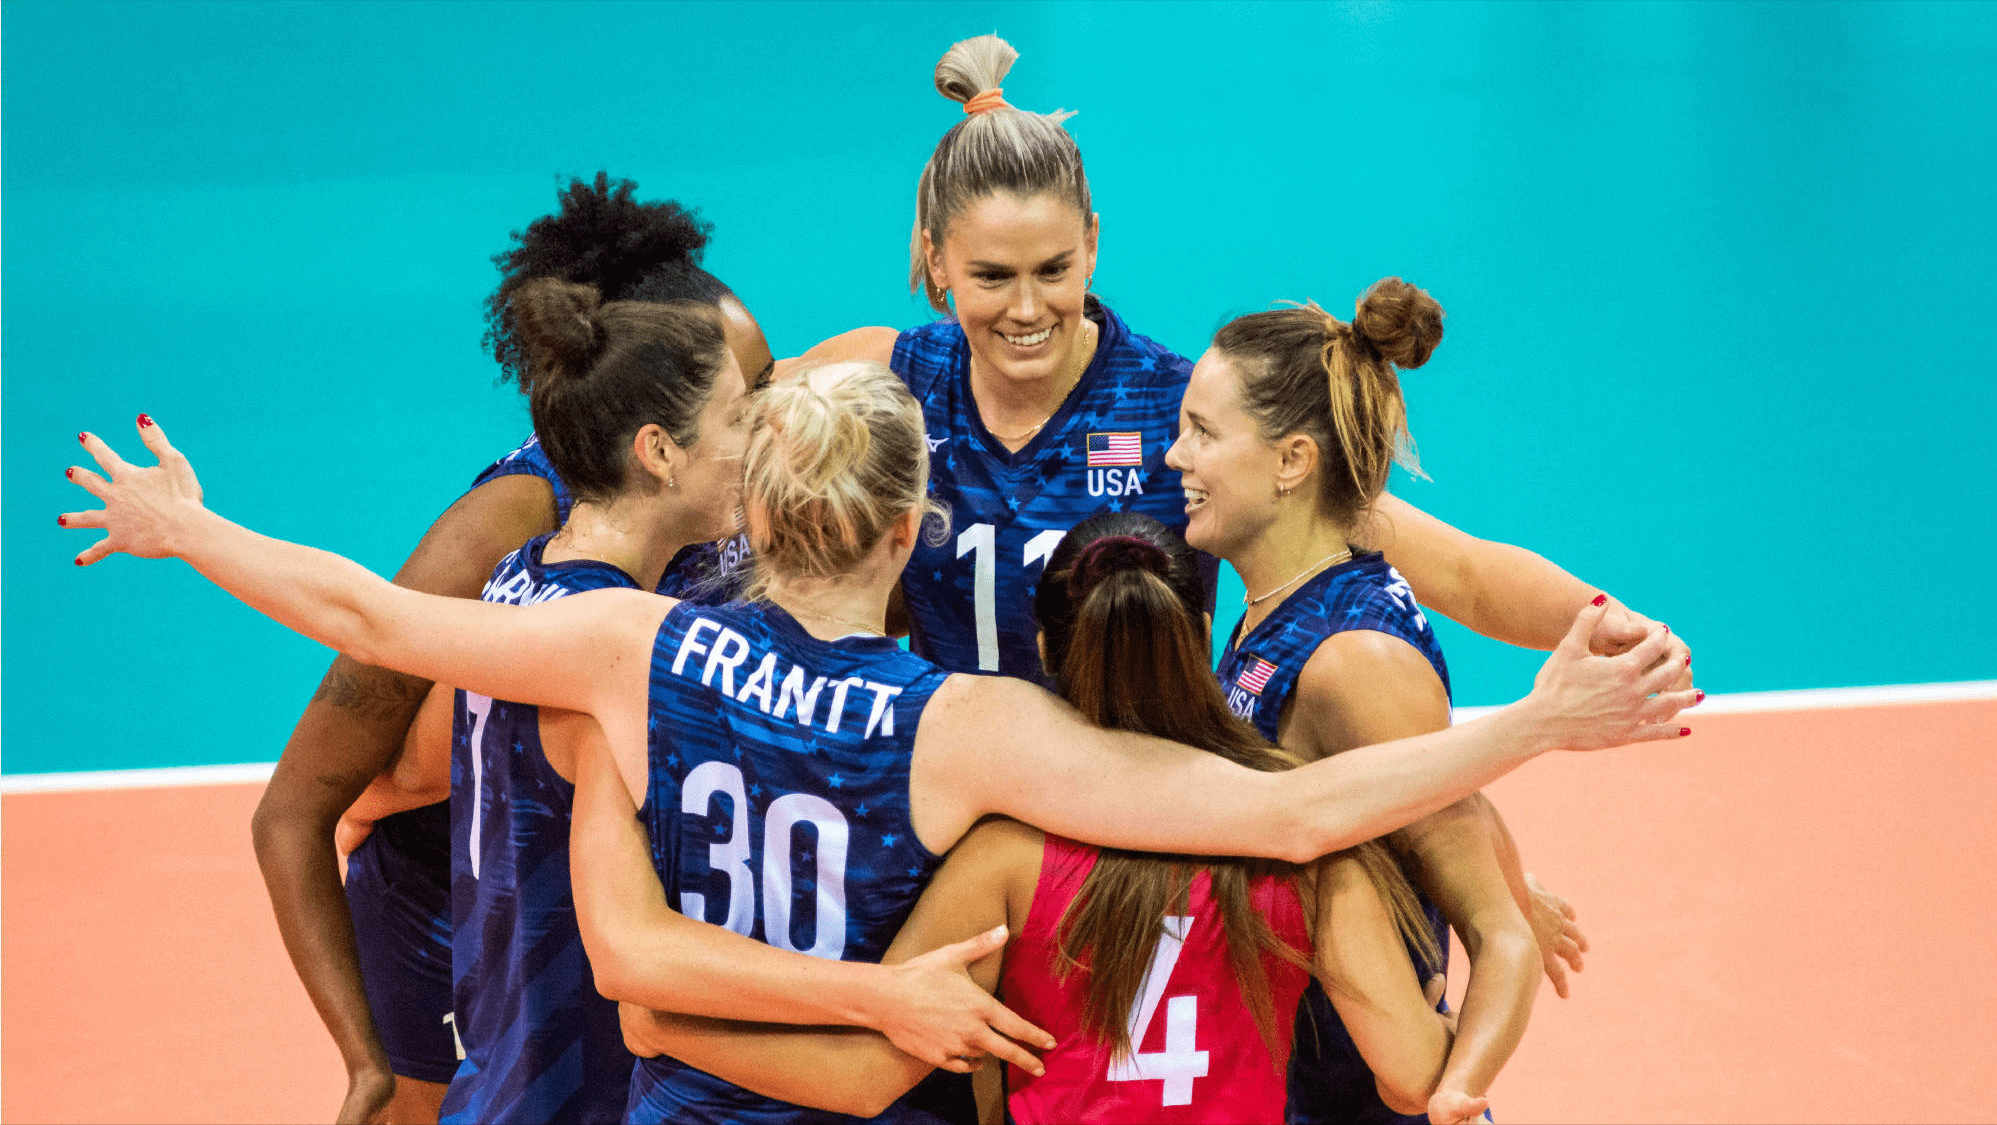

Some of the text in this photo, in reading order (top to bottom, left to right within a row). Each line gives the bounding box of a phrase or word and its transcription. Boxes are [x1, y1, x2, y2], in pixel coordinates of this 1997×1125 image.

[1088, 469, 1143, 496] USA
[720, 533, 751, 576] USA
[1228, 686, 1255, 722] USA
[680, 761, 849, 961] 30
[1107, 916, 1209, 1106] 4
